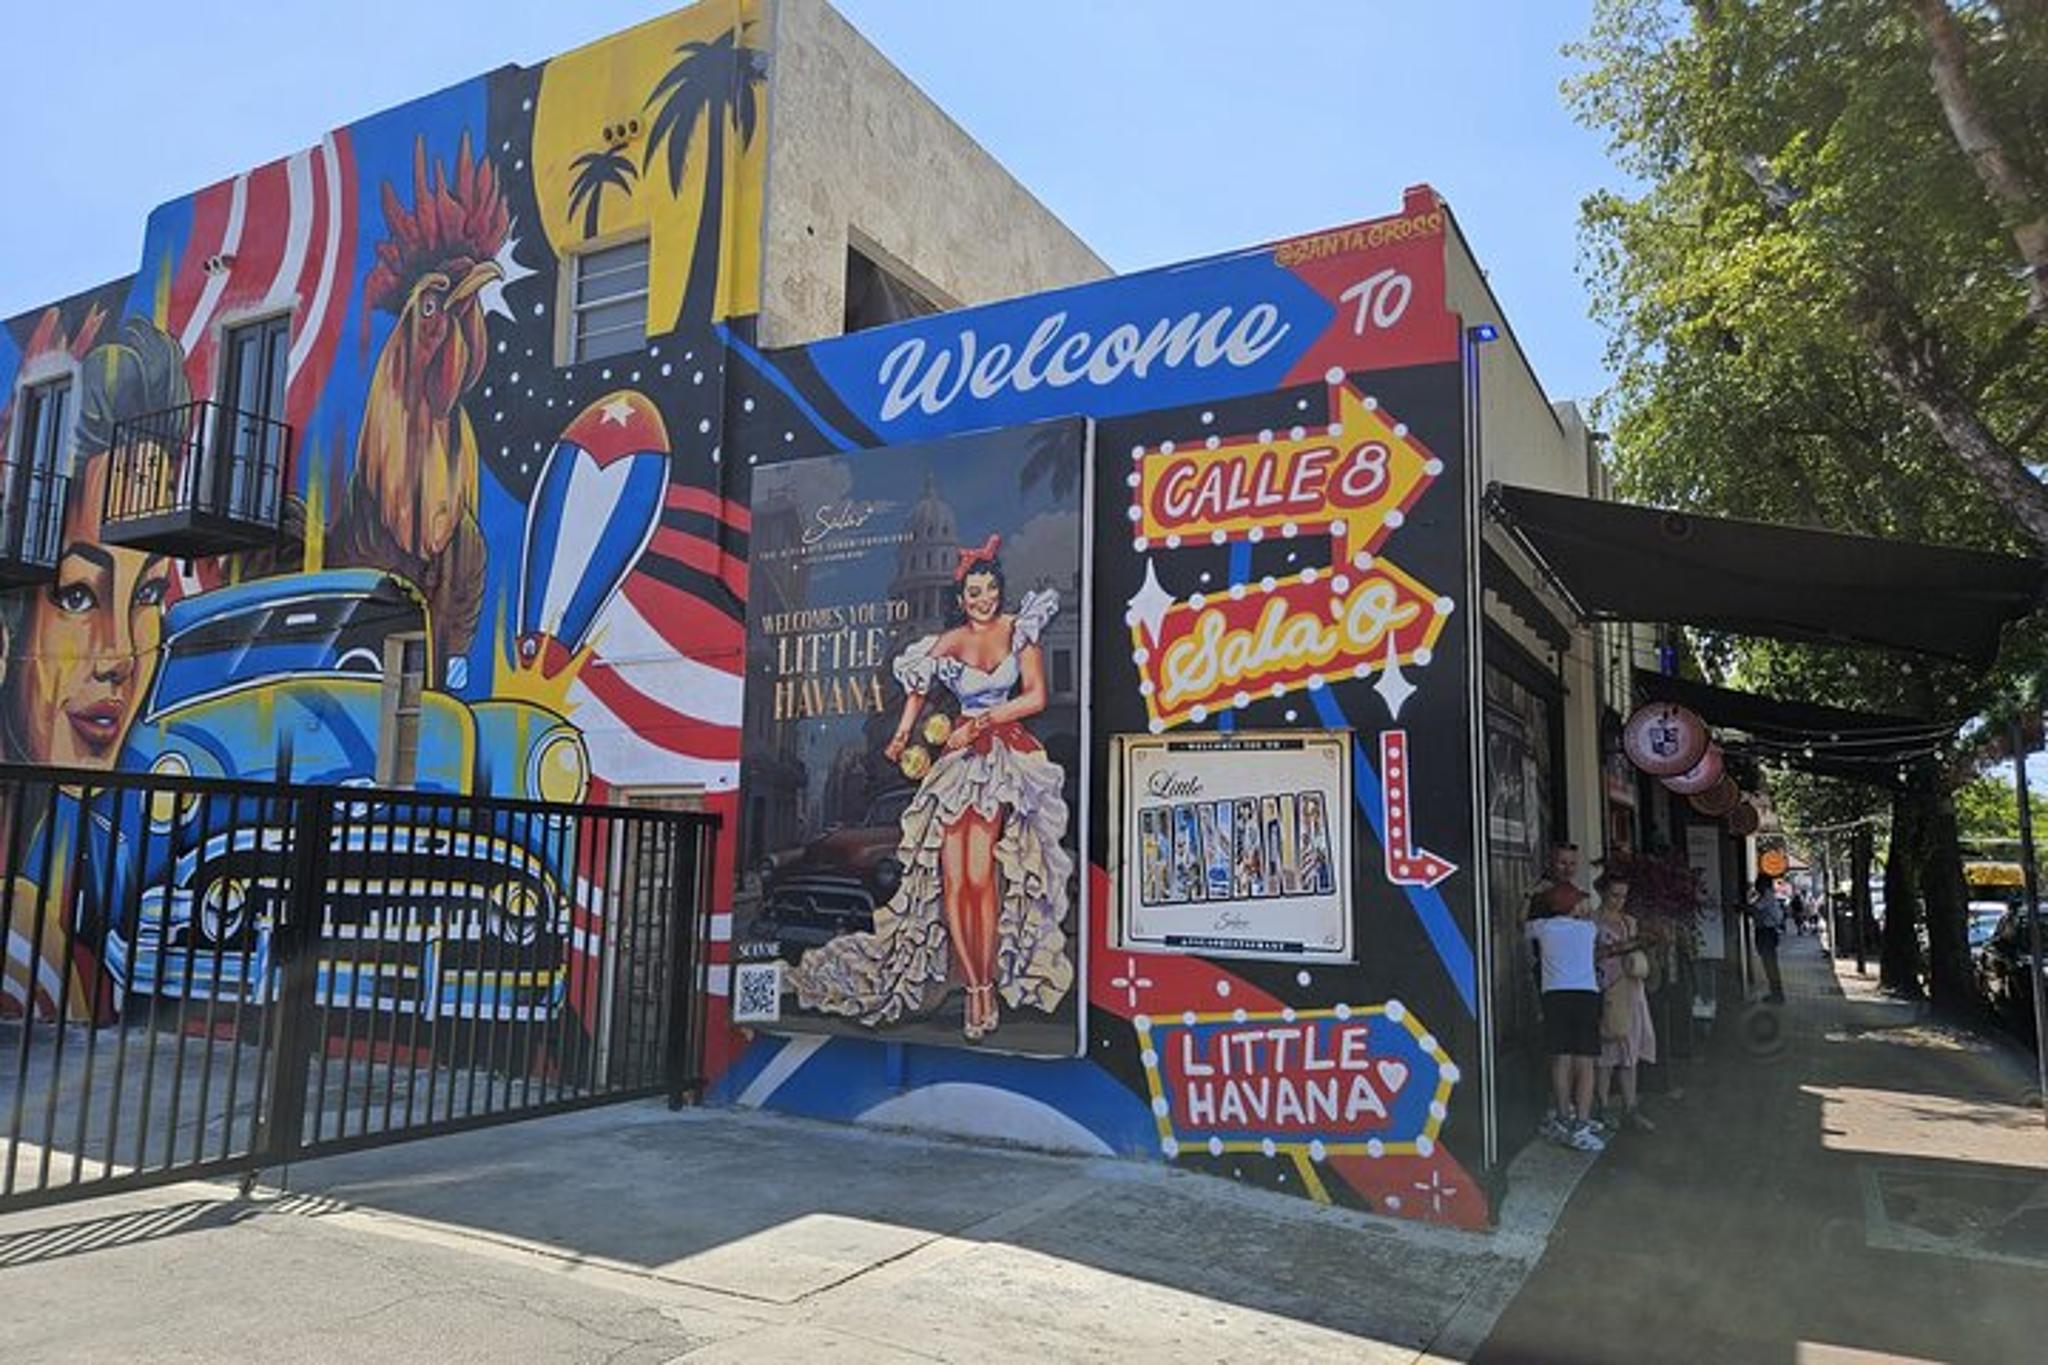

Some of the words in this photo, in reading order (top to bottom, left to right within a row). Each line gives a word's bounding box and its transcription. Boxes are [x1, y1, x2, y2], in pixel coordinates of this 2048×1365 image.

[878, 303, 1291, 422] Welcome
[1340, 268, 1412, 335] TO
[1161, 447, 1334, 520] CALLE
[1338, 442, 1389, 500] 8
[761, 605, 846, 634] WELCOMES
[848, 602, 882, 625] YOU
[885, 599, 909, 622] TO
[778, 627, 886, 675] LITTLE
[773, 674, 885, 720] HAVANA
[1147, 769, 1204, 798] Little
[1182, 1025, 1370, 1076] LITTLE
[1187, 1075, 1388, 1126] HAVANA
